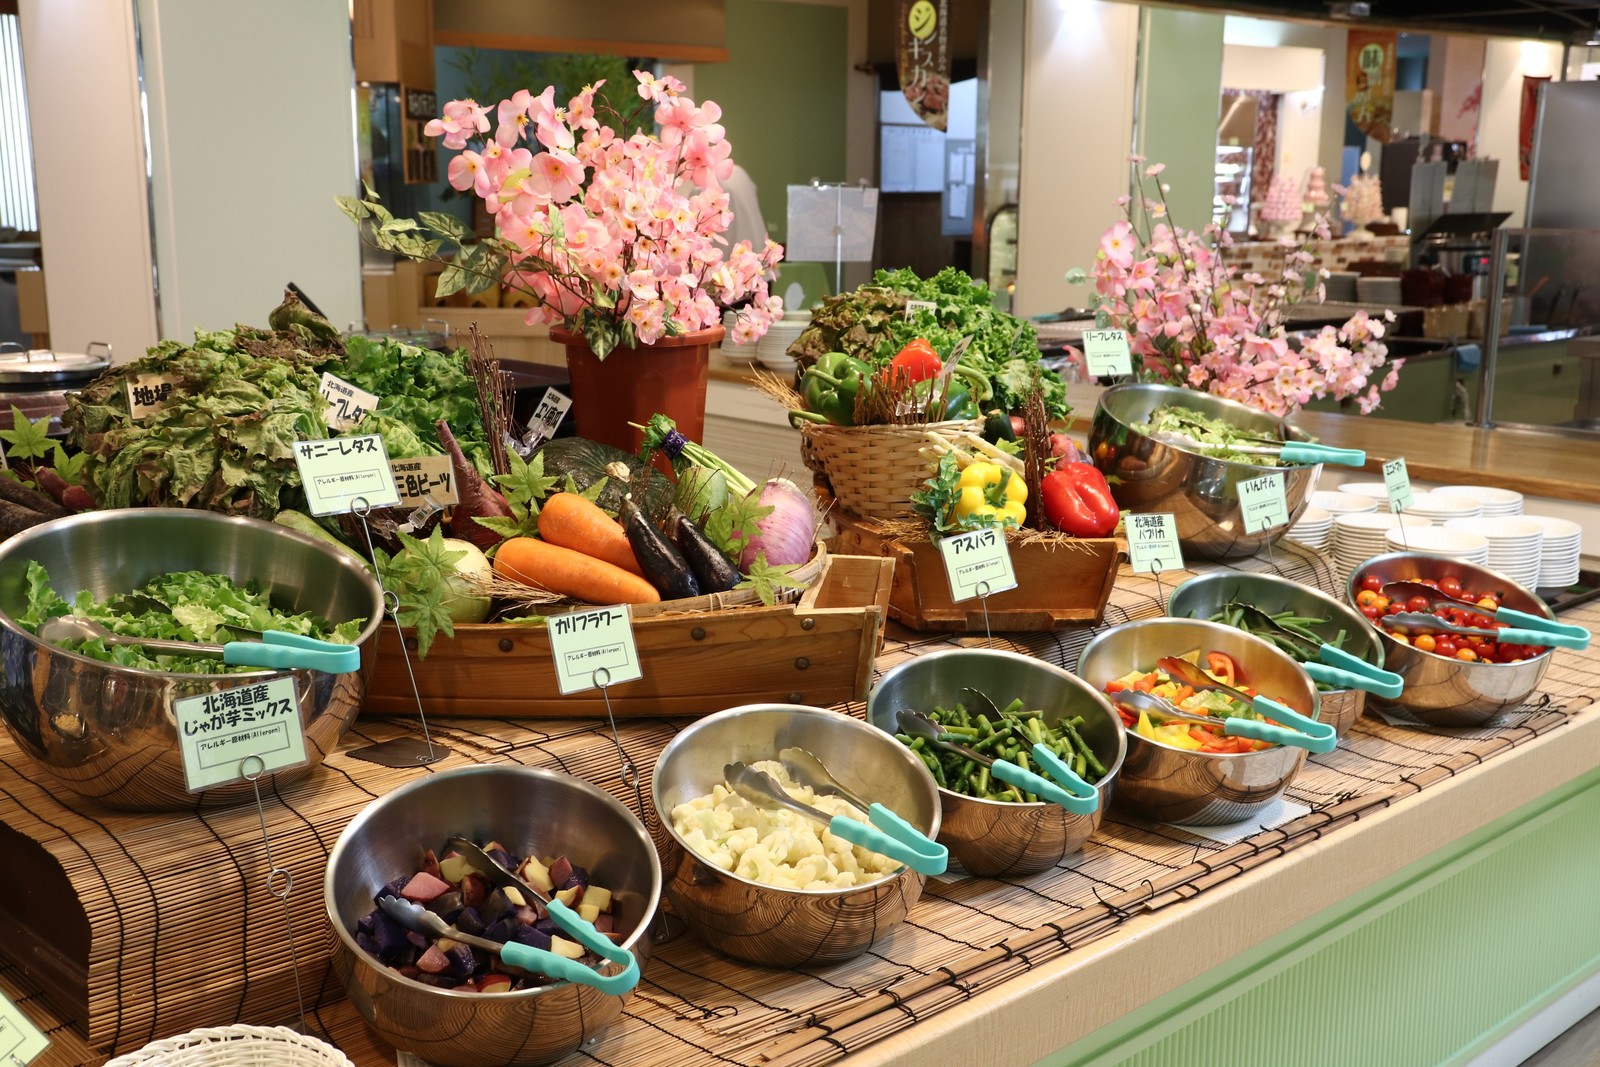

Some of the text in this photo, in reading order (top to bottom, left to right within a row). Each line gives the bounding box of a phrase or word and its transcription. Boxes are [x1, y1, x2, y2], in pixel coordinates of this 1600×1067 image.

[1086, 331, 1123, 342] リーフレタス
[300, 437, 378, 460] サニーレタス
[395, 472, 451, 498] 三色ビーツ
[1245, 477, 1276, 494] いんげん
[1134, 515, 1165, 528] 北海道産
[951, 530, 996, 555] アスパラ
[1139, 528, 1166, 540] パプリカ
[555, 610, 623, 635] カリフラワー
[202, 684, 270, 715] 北海道産
[184, 698, 293, 737] じゃが芋ミックス
